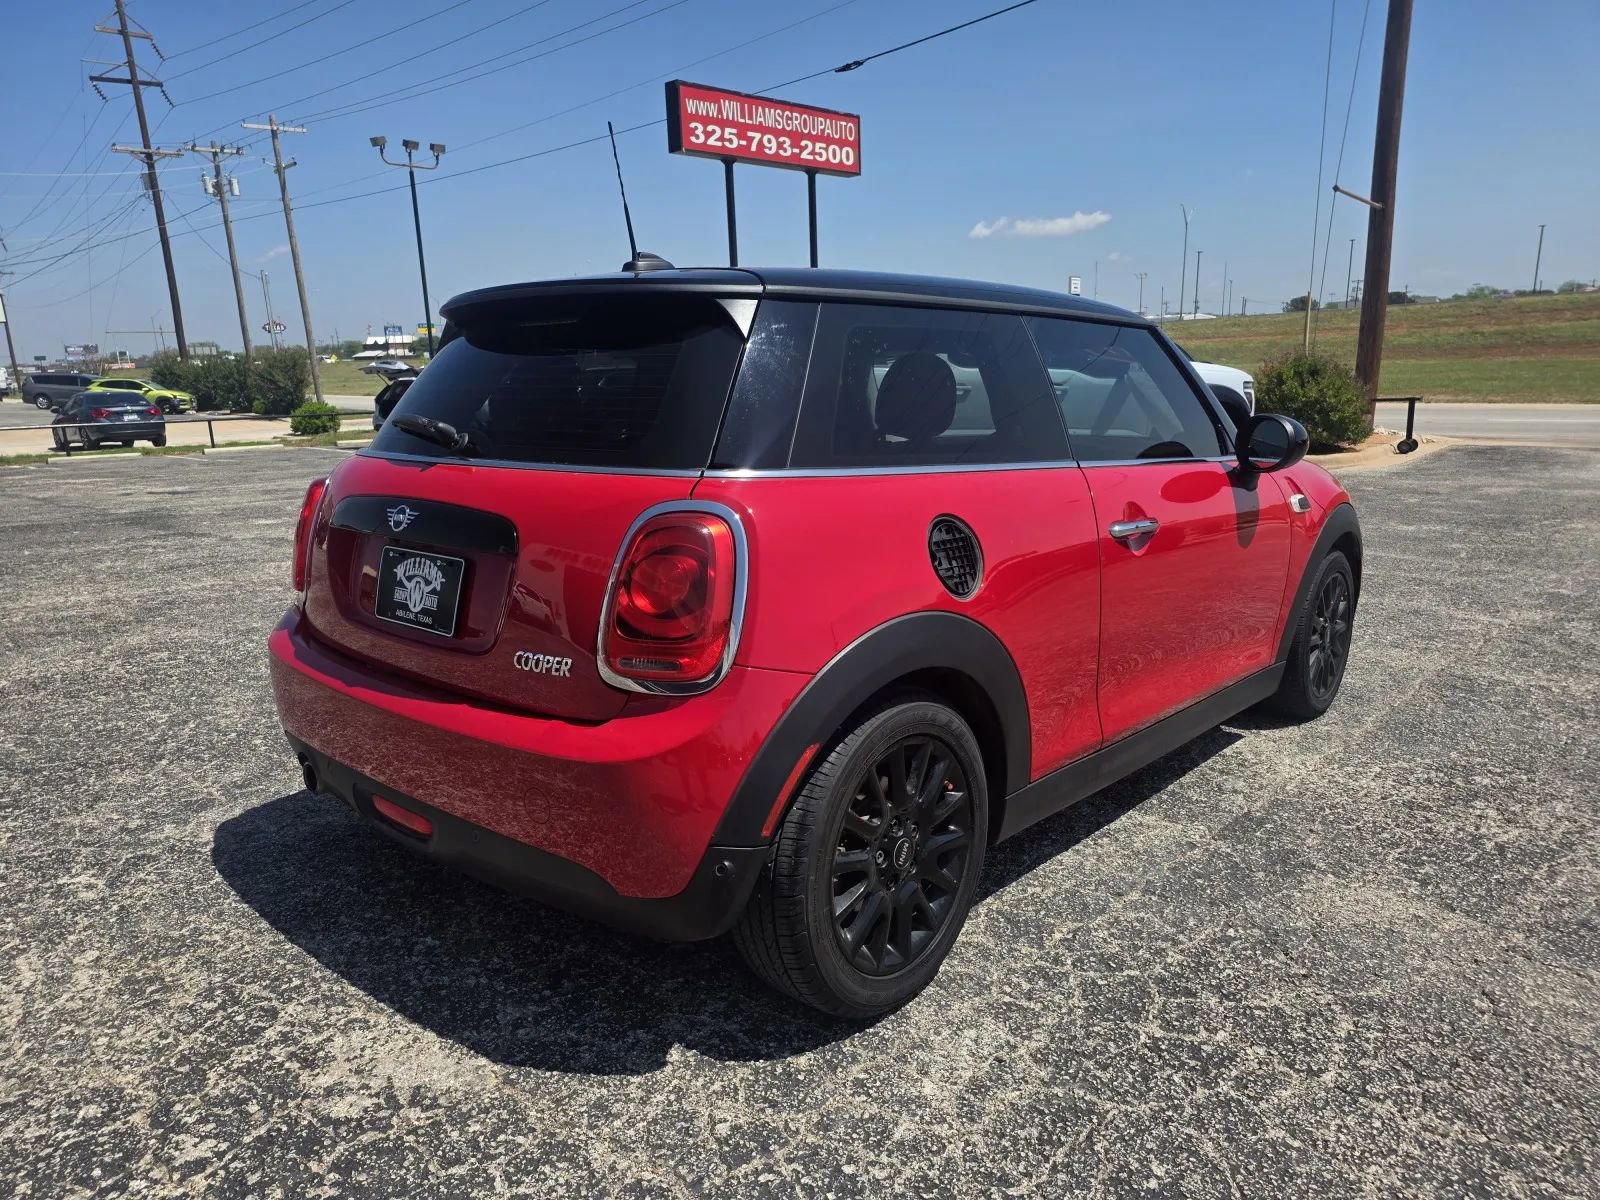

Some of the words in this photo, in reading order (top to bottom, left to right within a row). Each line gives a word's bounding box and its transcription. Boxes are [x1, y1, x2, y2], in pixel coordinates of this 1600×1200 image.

[685, 98, 855, 141] www.WILLIAMSGROUPAUTO
[688, 122, 854, 165] 325-793-2500
[394, 557, 445, 591] WILLIAMS
[395, 609, 417, 622] ABILENE,
[417, 614, 433, 625] TEXAS
[513, 650, 572, 678] COOPER
[898, 842, 909, 865] MINI
